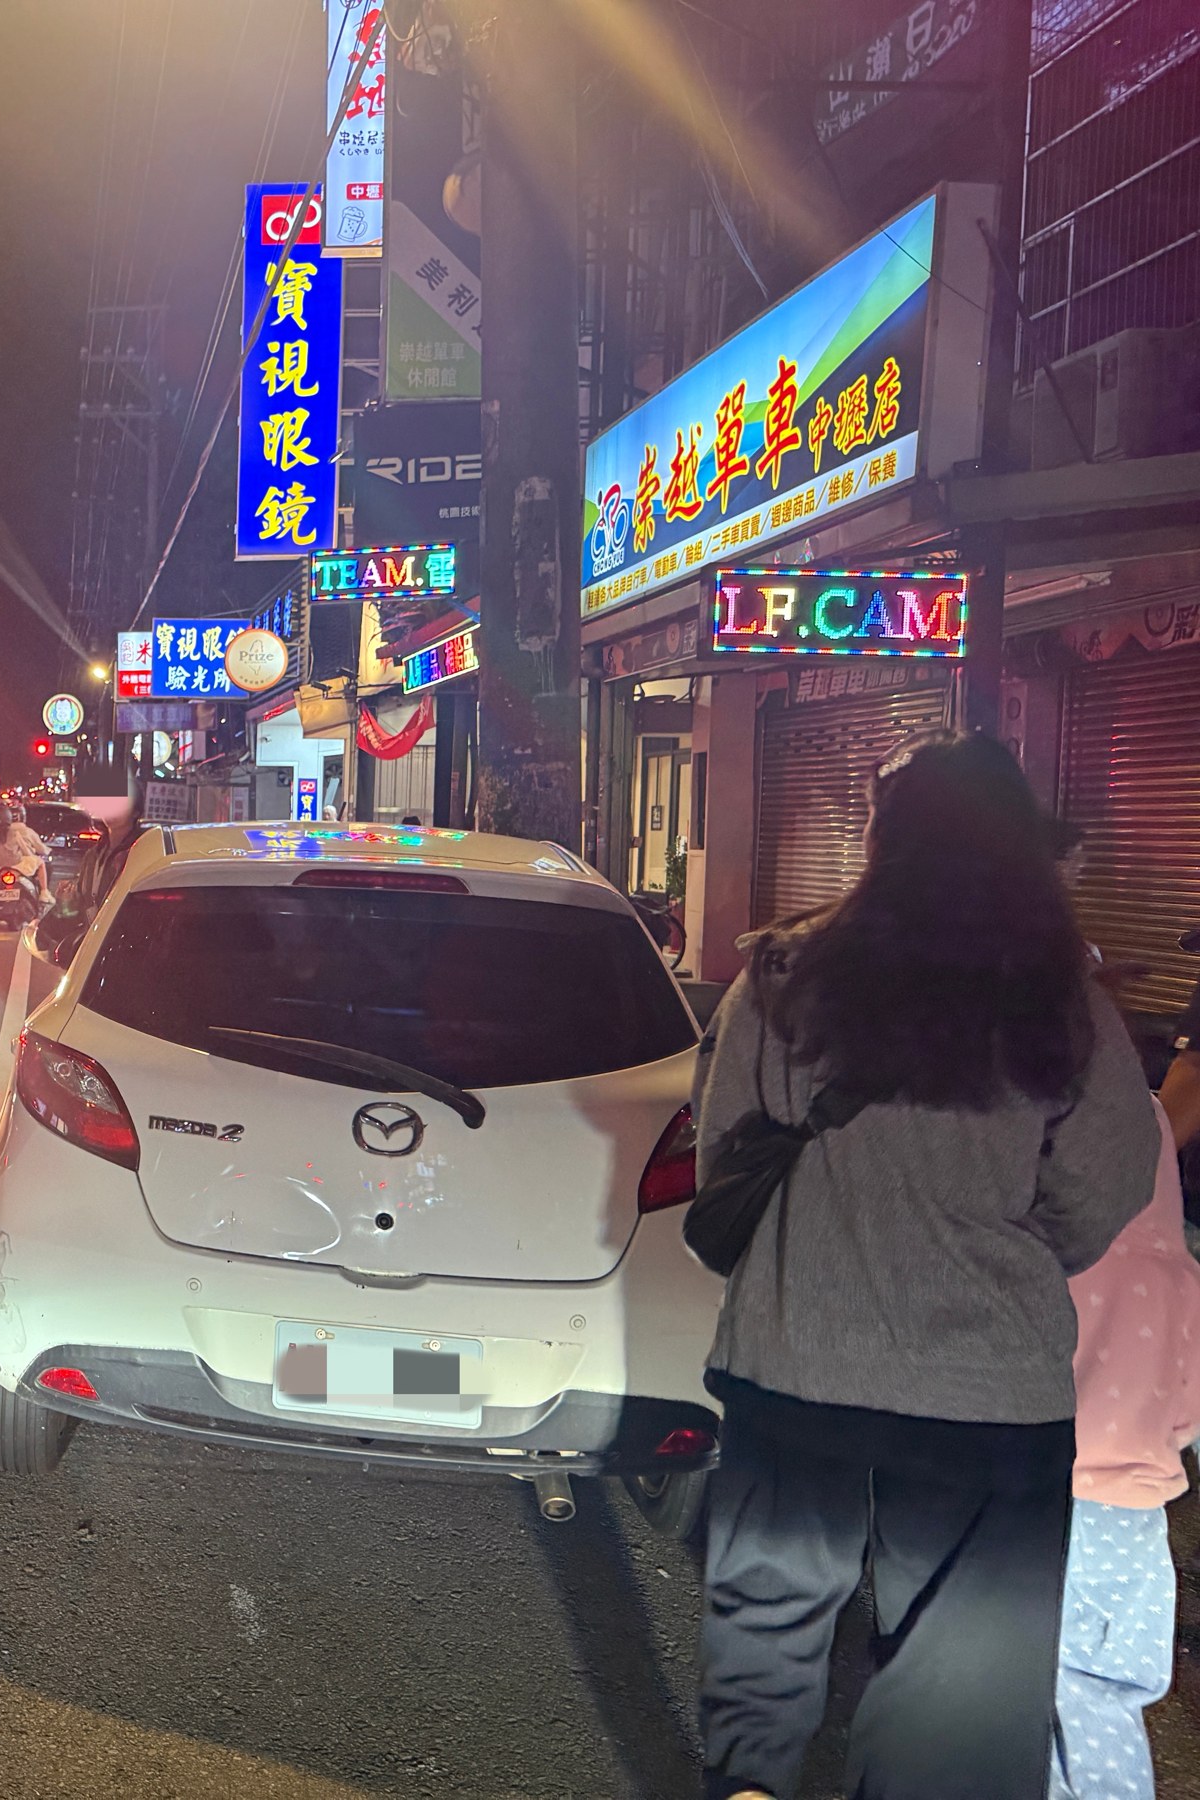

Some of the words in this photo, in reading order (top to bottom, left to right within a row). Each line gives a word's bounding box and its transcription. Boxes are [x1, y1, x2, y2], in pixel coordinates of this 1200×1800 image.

[415, 257, 482, 340] 美利
[255, 258, 319, 545] 寶視眼鏡
[633, 355, 802, 553] 崇越單車
[808, 356, 901, 474] 中壢店
[165, 665, 231, 693] 驗光所
[239, 650, 274, 662] Prize
[218, 1123, 245, 1142] 2
